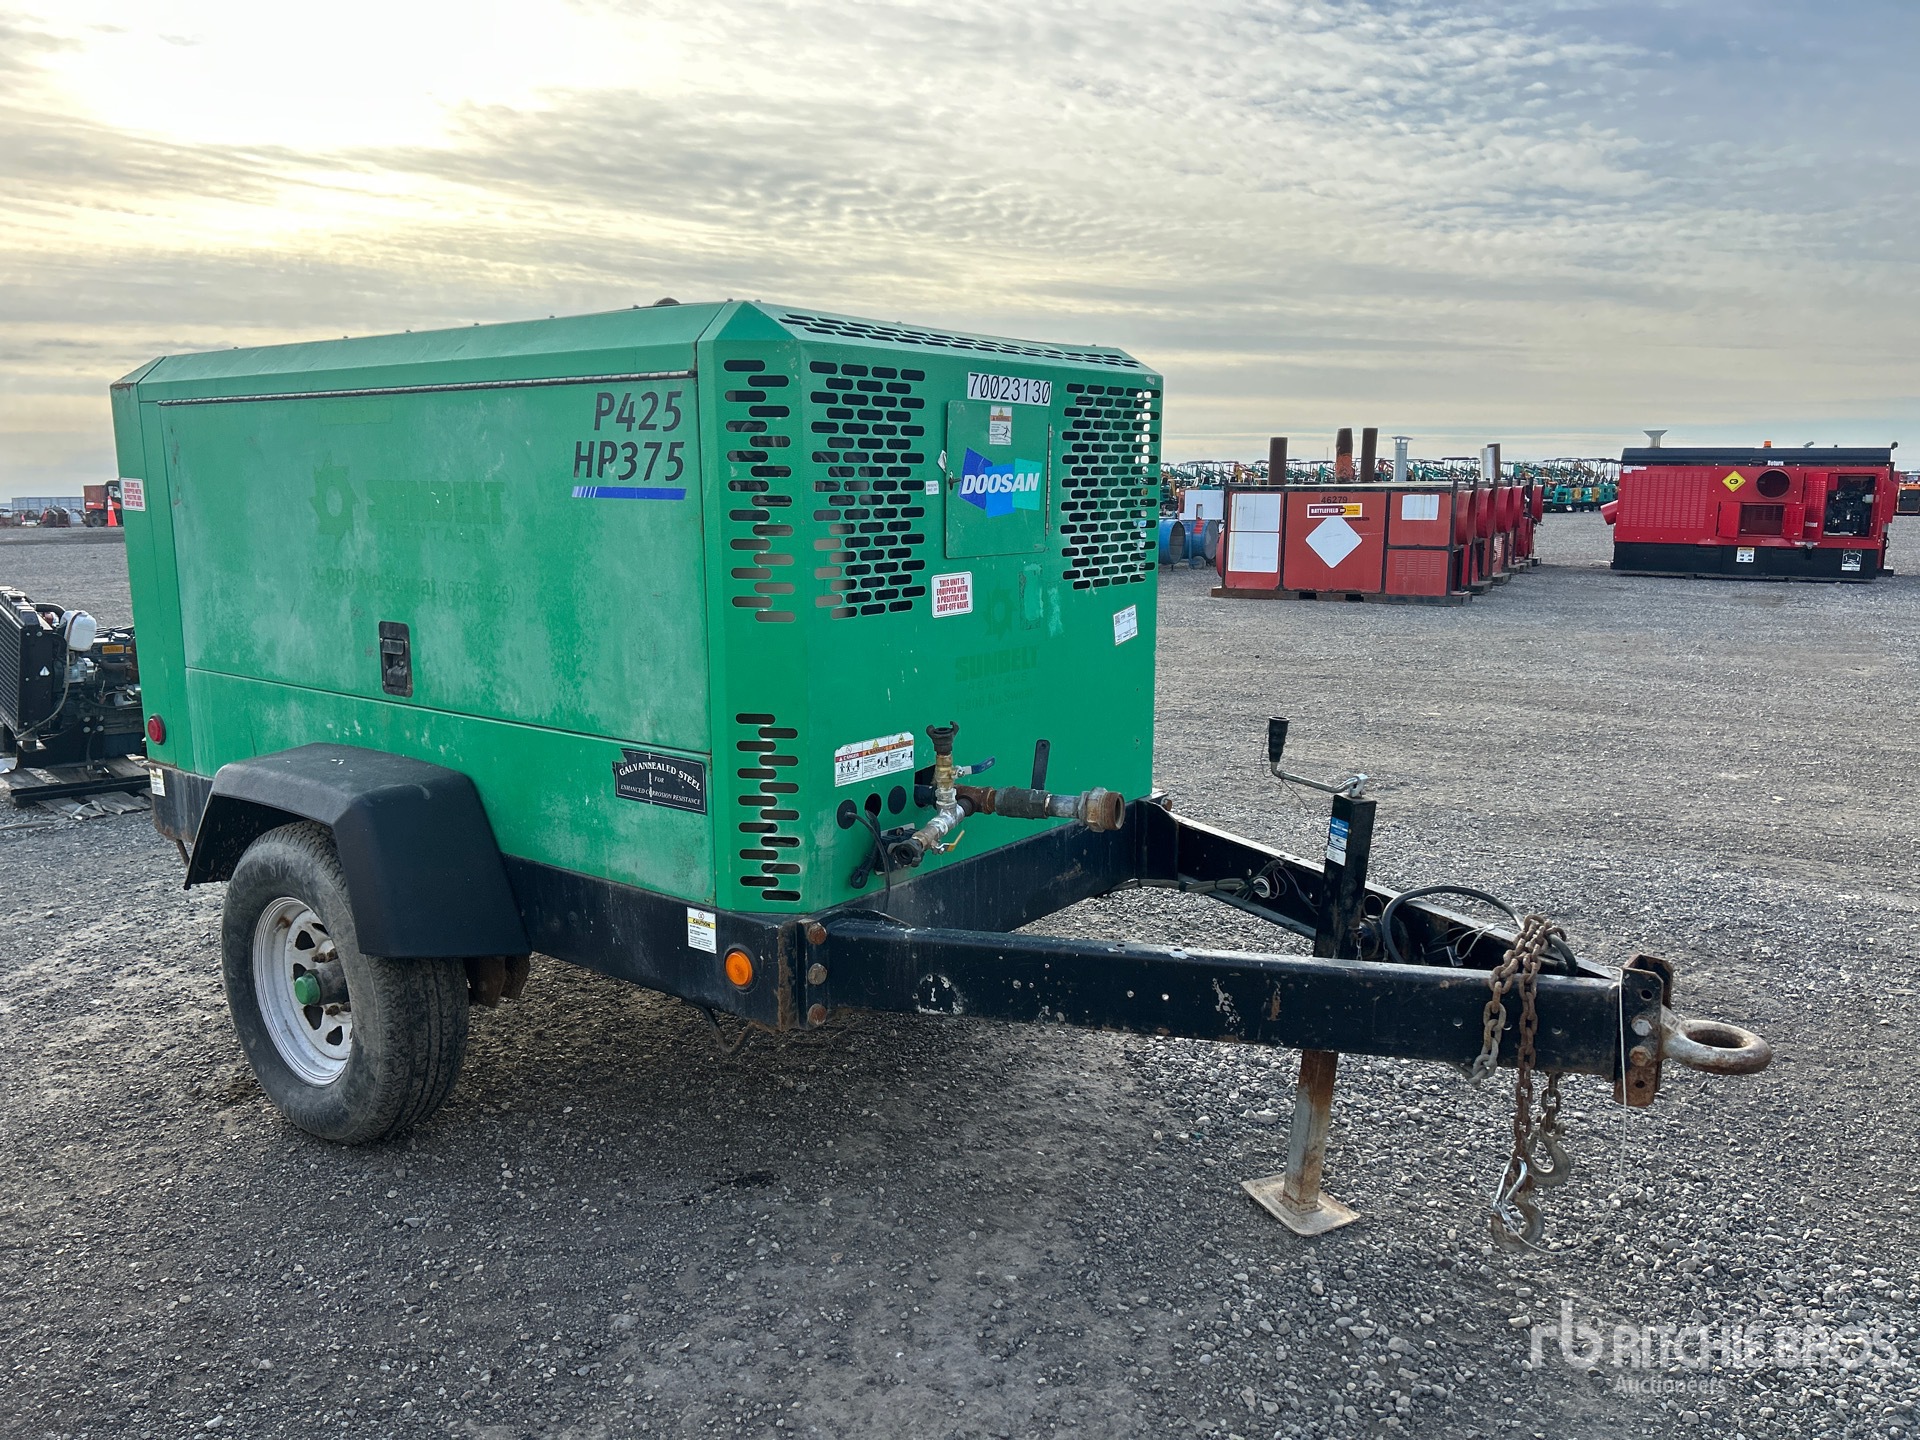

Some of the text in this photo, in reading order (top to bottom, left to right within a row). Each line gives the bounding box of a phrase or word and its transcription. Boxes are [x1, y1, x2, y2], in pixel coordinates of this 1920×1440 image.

[969, 373, 1051, 404] 70023130
[594, 390, 683, 432] P425
[573, 440, 685, 482] HP375
[961, 472, 1040, 495] DOOSAN
[1321, 495, 1348, 504] 46279
[936, 585, 968, 596] EQUIPPED WITH
[939, 579, 949, 587] THIS
[950, 578, 959, 586] UNIT
[936, 601, 969, 612] SHUT-OFF VALVE
[941, 594, 959, 603] POSITIVE
[619, 761, 701, 791] GALVANNEALED STEEL
[620, 784, 701, 805] ENHANCED CORROSION RESISTANCE
